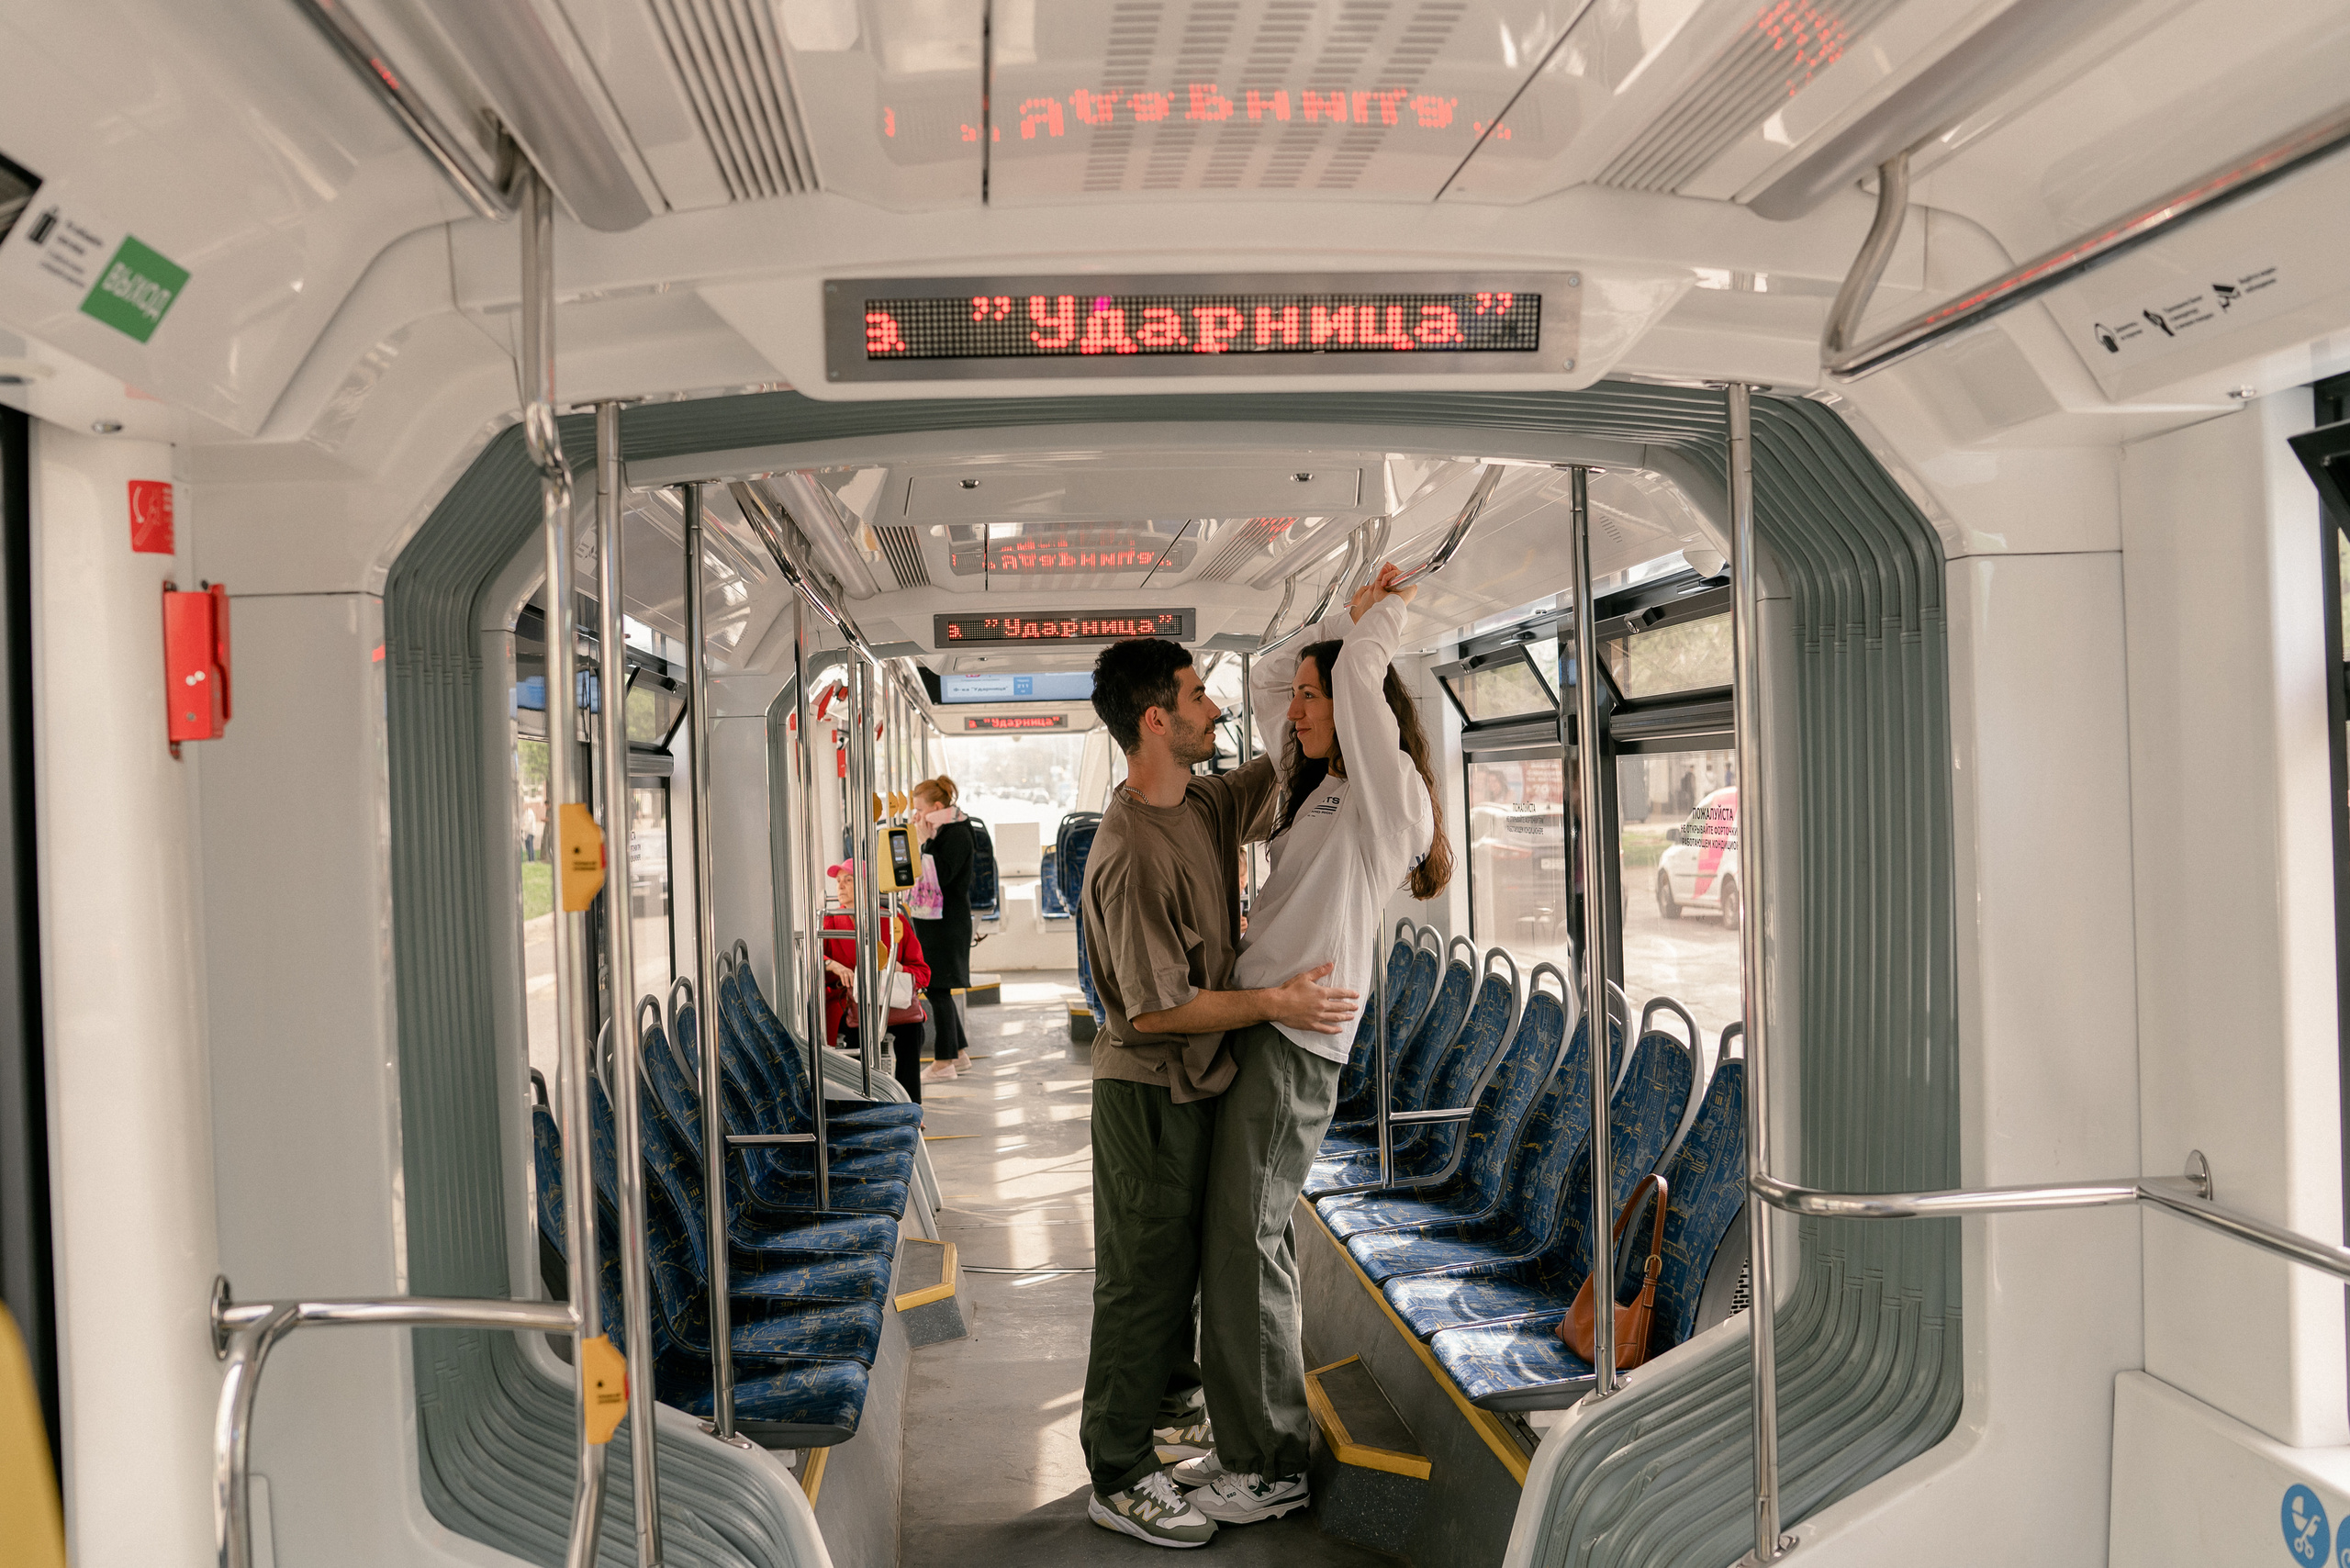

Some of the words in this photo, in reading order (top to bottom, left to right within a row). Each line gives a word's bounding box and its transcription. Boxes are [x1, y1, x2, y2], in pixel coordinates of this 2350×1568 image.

[101, 261, 172, 320] ВЫХОД
[972, 292, 1513, 354] "Ударница"
[1693, 804, 1733, 821] ПОЖАЛУЙСТА
[1686, 823, 1714, 834] ОТКРЫВАЙТЕ
[1682, 837, 1712, 849] РАБОТАЮЩЕМ
[1133, 1499, 1162, 1522] N
